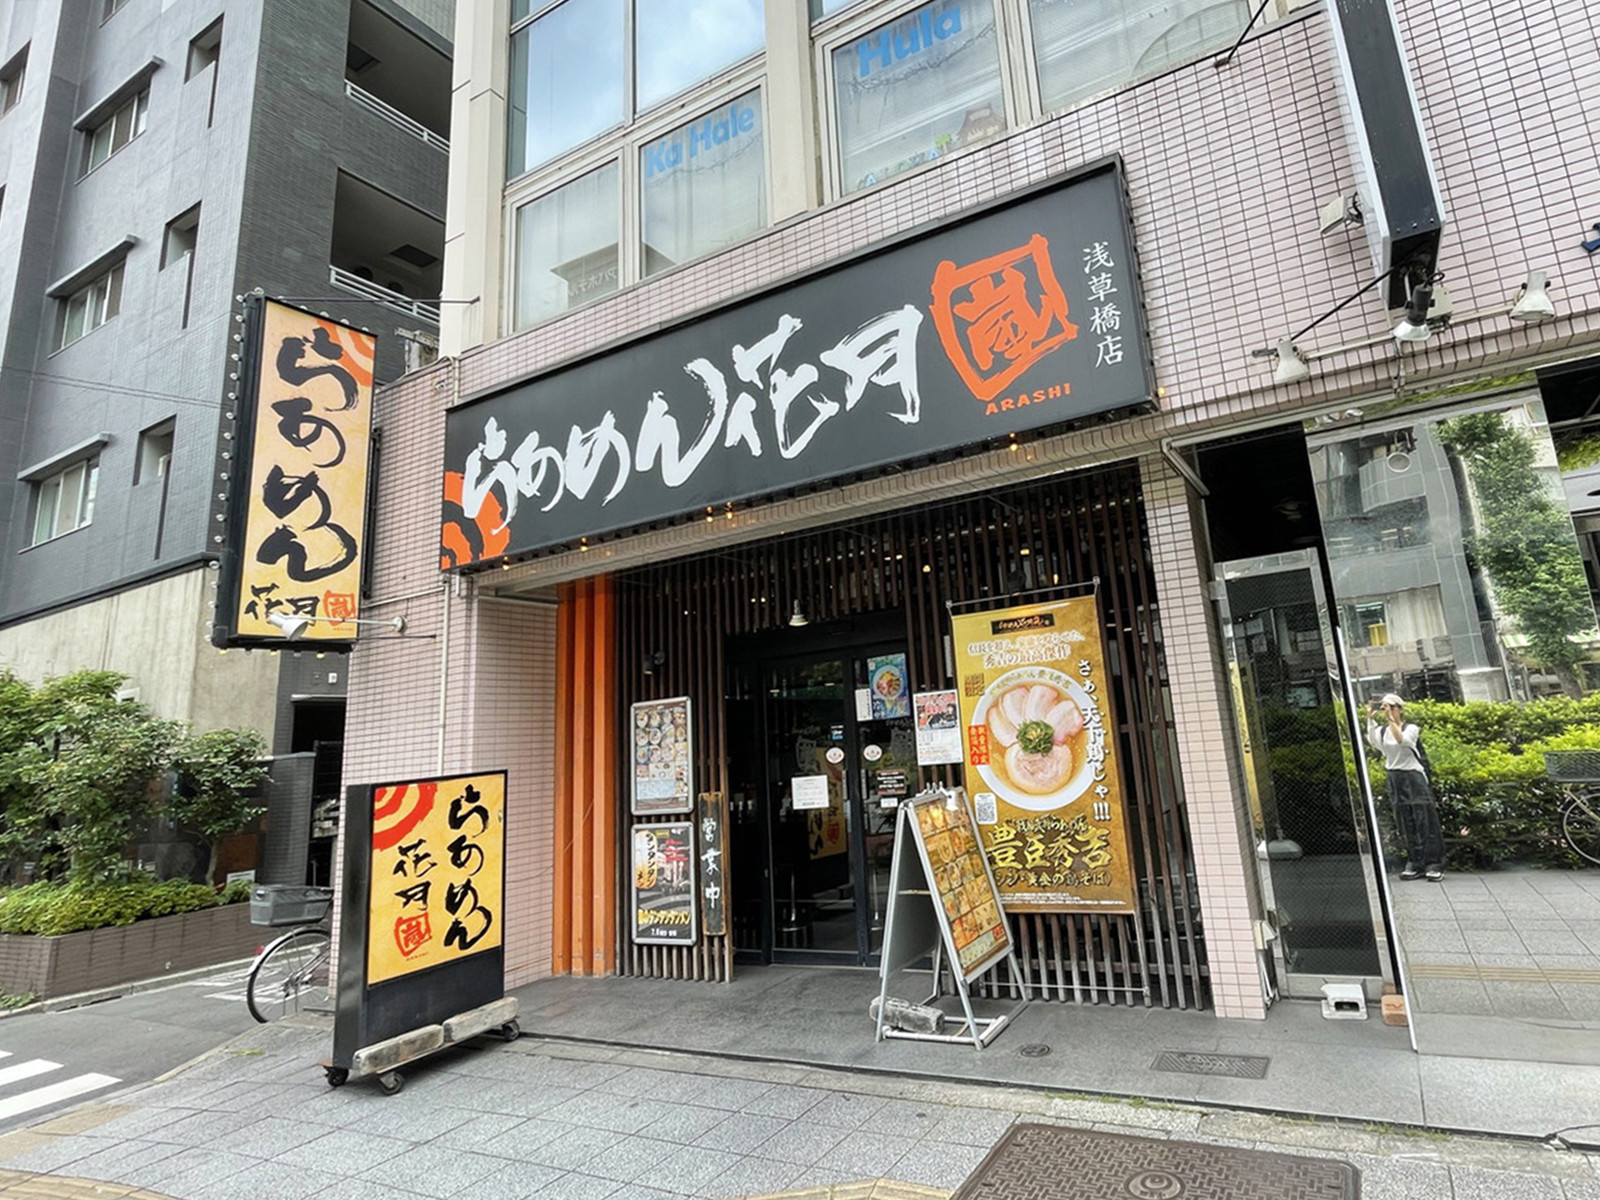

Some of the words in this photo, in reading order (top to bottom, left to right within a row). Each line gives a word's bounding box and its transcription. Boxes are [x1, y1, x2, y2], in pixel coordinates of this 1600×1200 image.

[857, 6, 962, 78] Hula
[647, 141, 683, 178] Ka
[689, 103, 754, 158] Hale
[1083, 241, 1124, 368] 浅草橋店
[985, 383, 1071, 415] ARASHI
[701, 817, 722, 909] 営業中
[985, 824, 1112, 869] 豊臣秀吉
